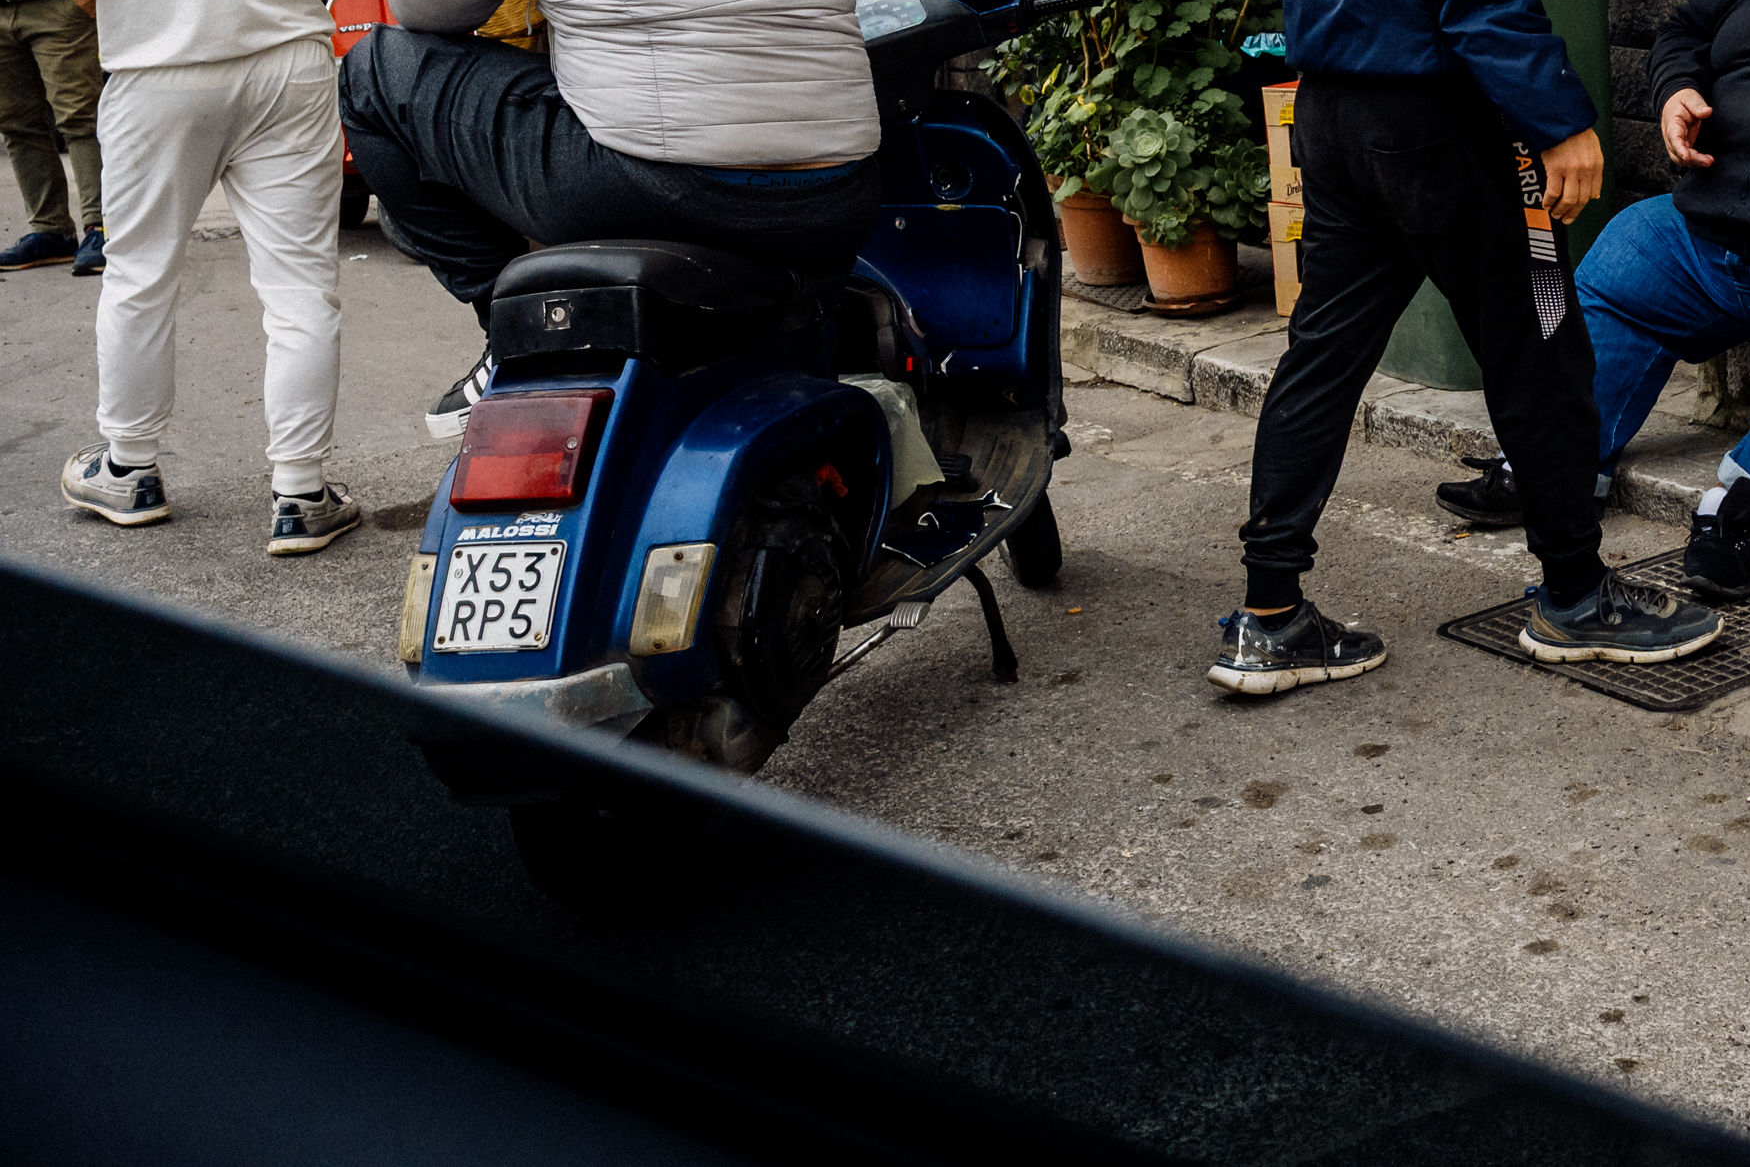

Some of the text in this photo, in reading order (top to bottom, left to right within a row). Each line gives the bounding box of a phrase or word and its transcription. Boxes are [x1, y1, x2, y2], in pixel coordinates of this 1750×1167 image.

[339, 22, 373, 33] vesp
[1512, 141, 1543, 206] PARIS
[457, 524, 559, 541] MALOSSI
[459, 551, 547, 595] X53
[449, 598, 538, 642] RP5
